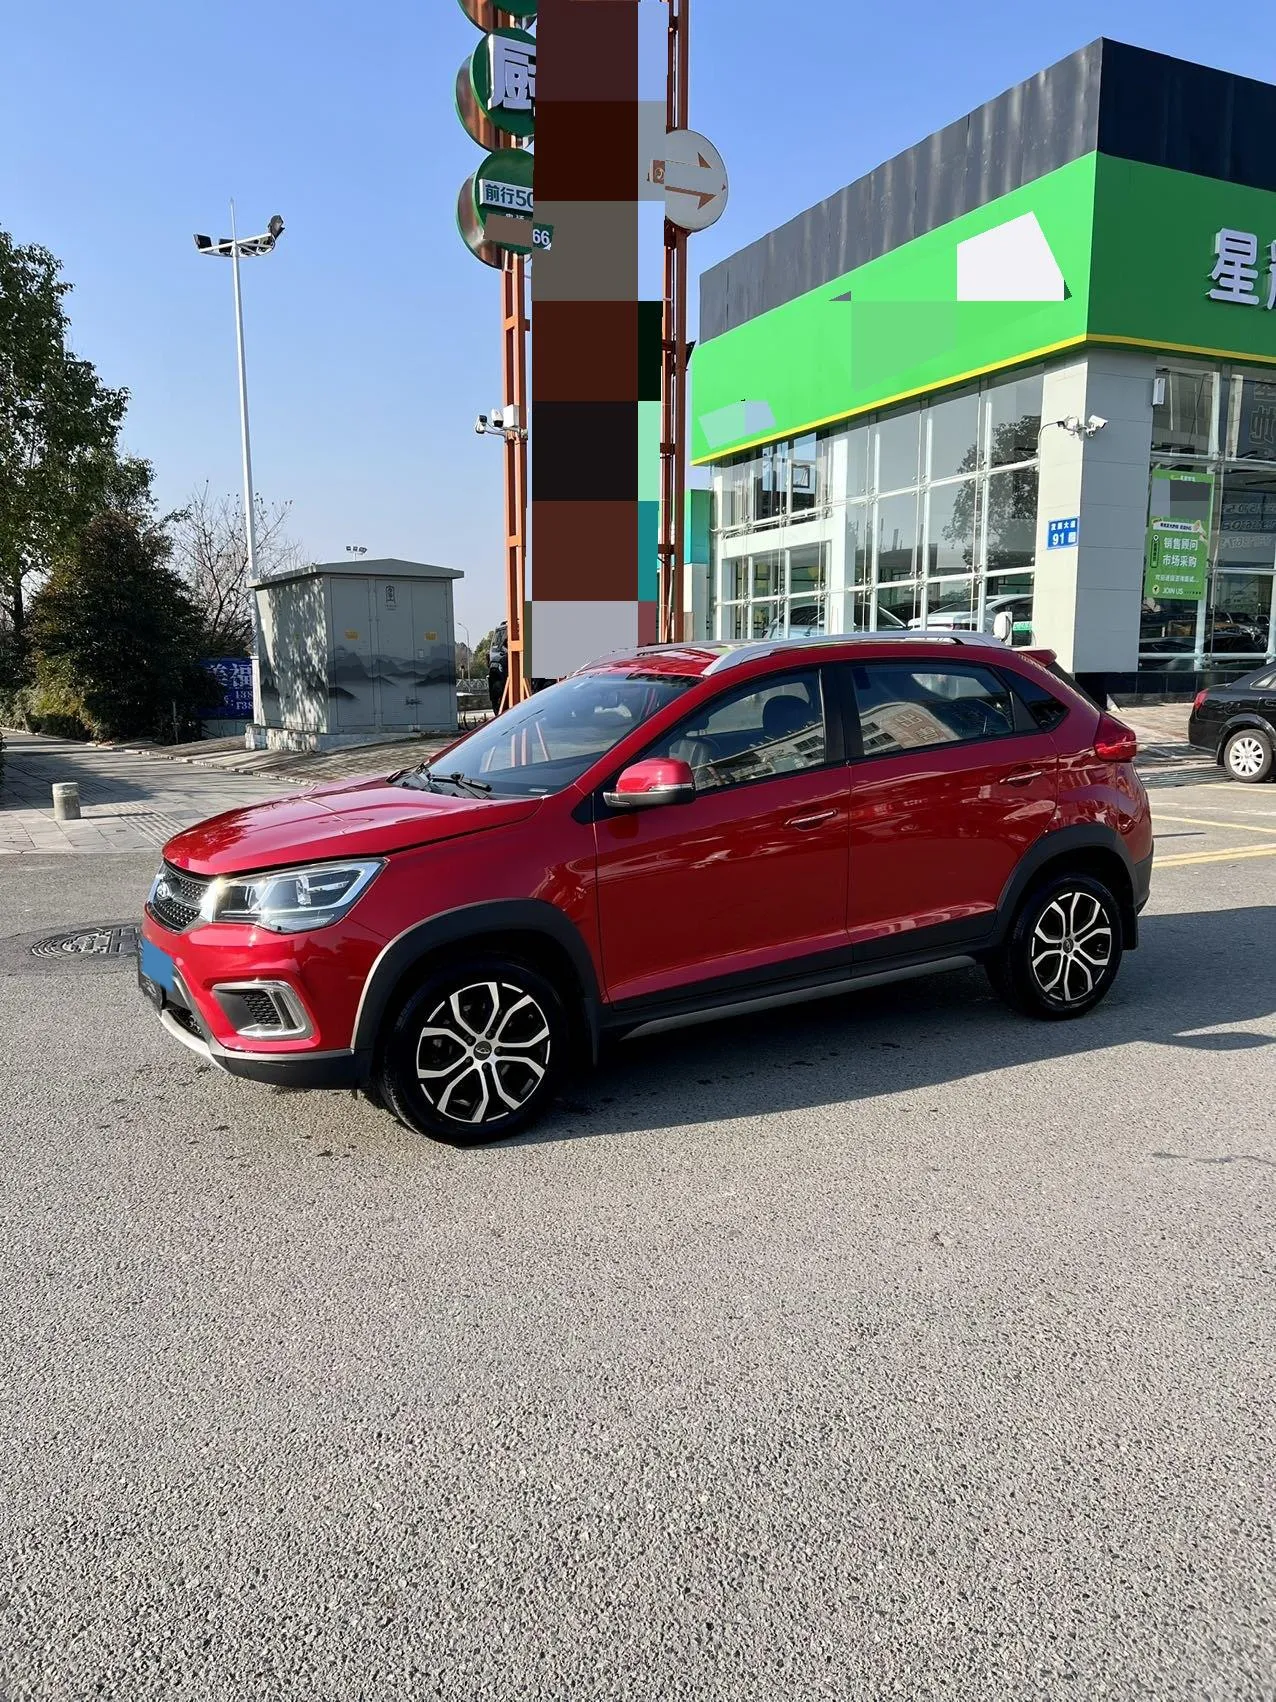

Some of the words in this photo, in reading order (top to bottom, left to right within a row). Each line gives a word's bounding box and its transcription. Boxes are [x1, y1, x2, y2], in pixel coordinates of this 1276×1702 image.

[1205, 227, 1276, 311] 星
[1164, 537, 1199, 551] 销售顾问
[1162, 555, 1198, 568] 市场采购
[1162, 587, 1176, 595] JOIN
[1176, 588, 1184, 596] US
